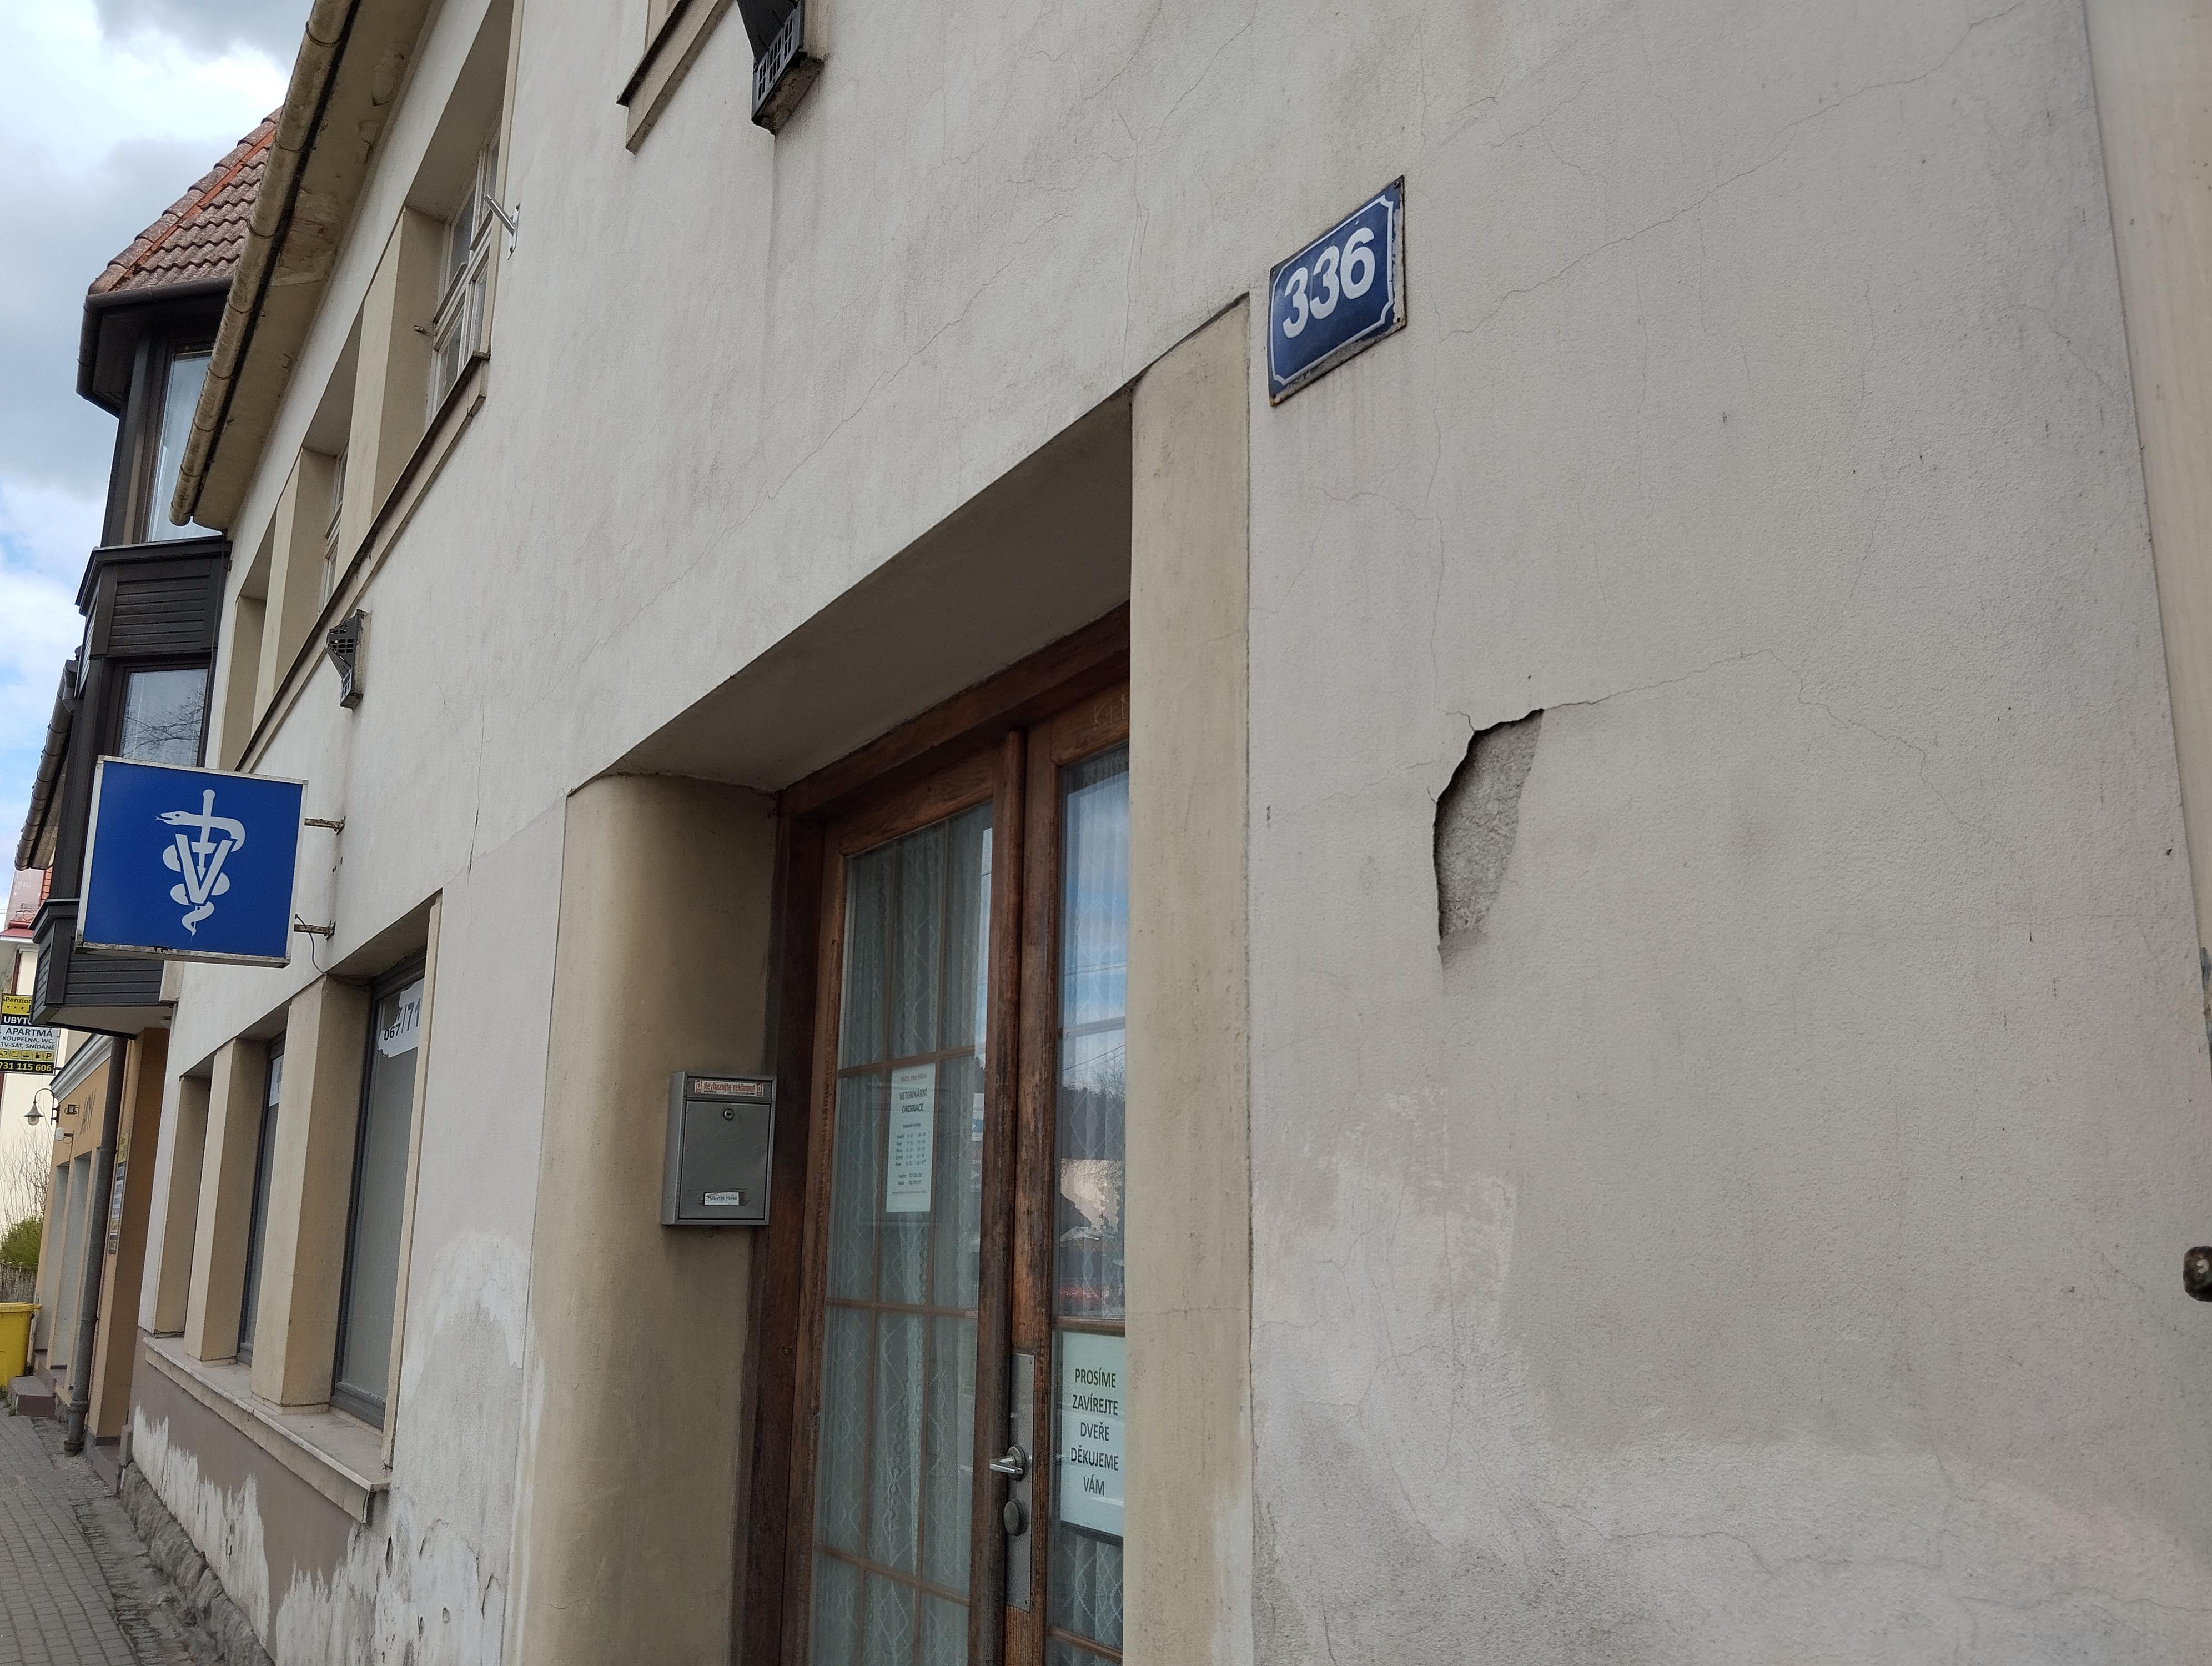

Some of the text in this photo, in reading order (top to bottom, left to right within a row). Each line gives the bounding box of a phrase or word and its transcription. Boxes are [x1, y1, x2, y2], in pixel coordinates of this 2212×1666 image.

[1283, 227, 1376, 339] 336
[1075, 1367, 1117, 1388] PROSÍME
[1072, 1393, 1118, 1416] ZAVÍREJTE
[1080, 1421, 1110, 1442] DVEŘE
[1070, 1444, 1119, 1471] DĚKUJEME
[1083, 1474, 1105, 1496] VÁM
